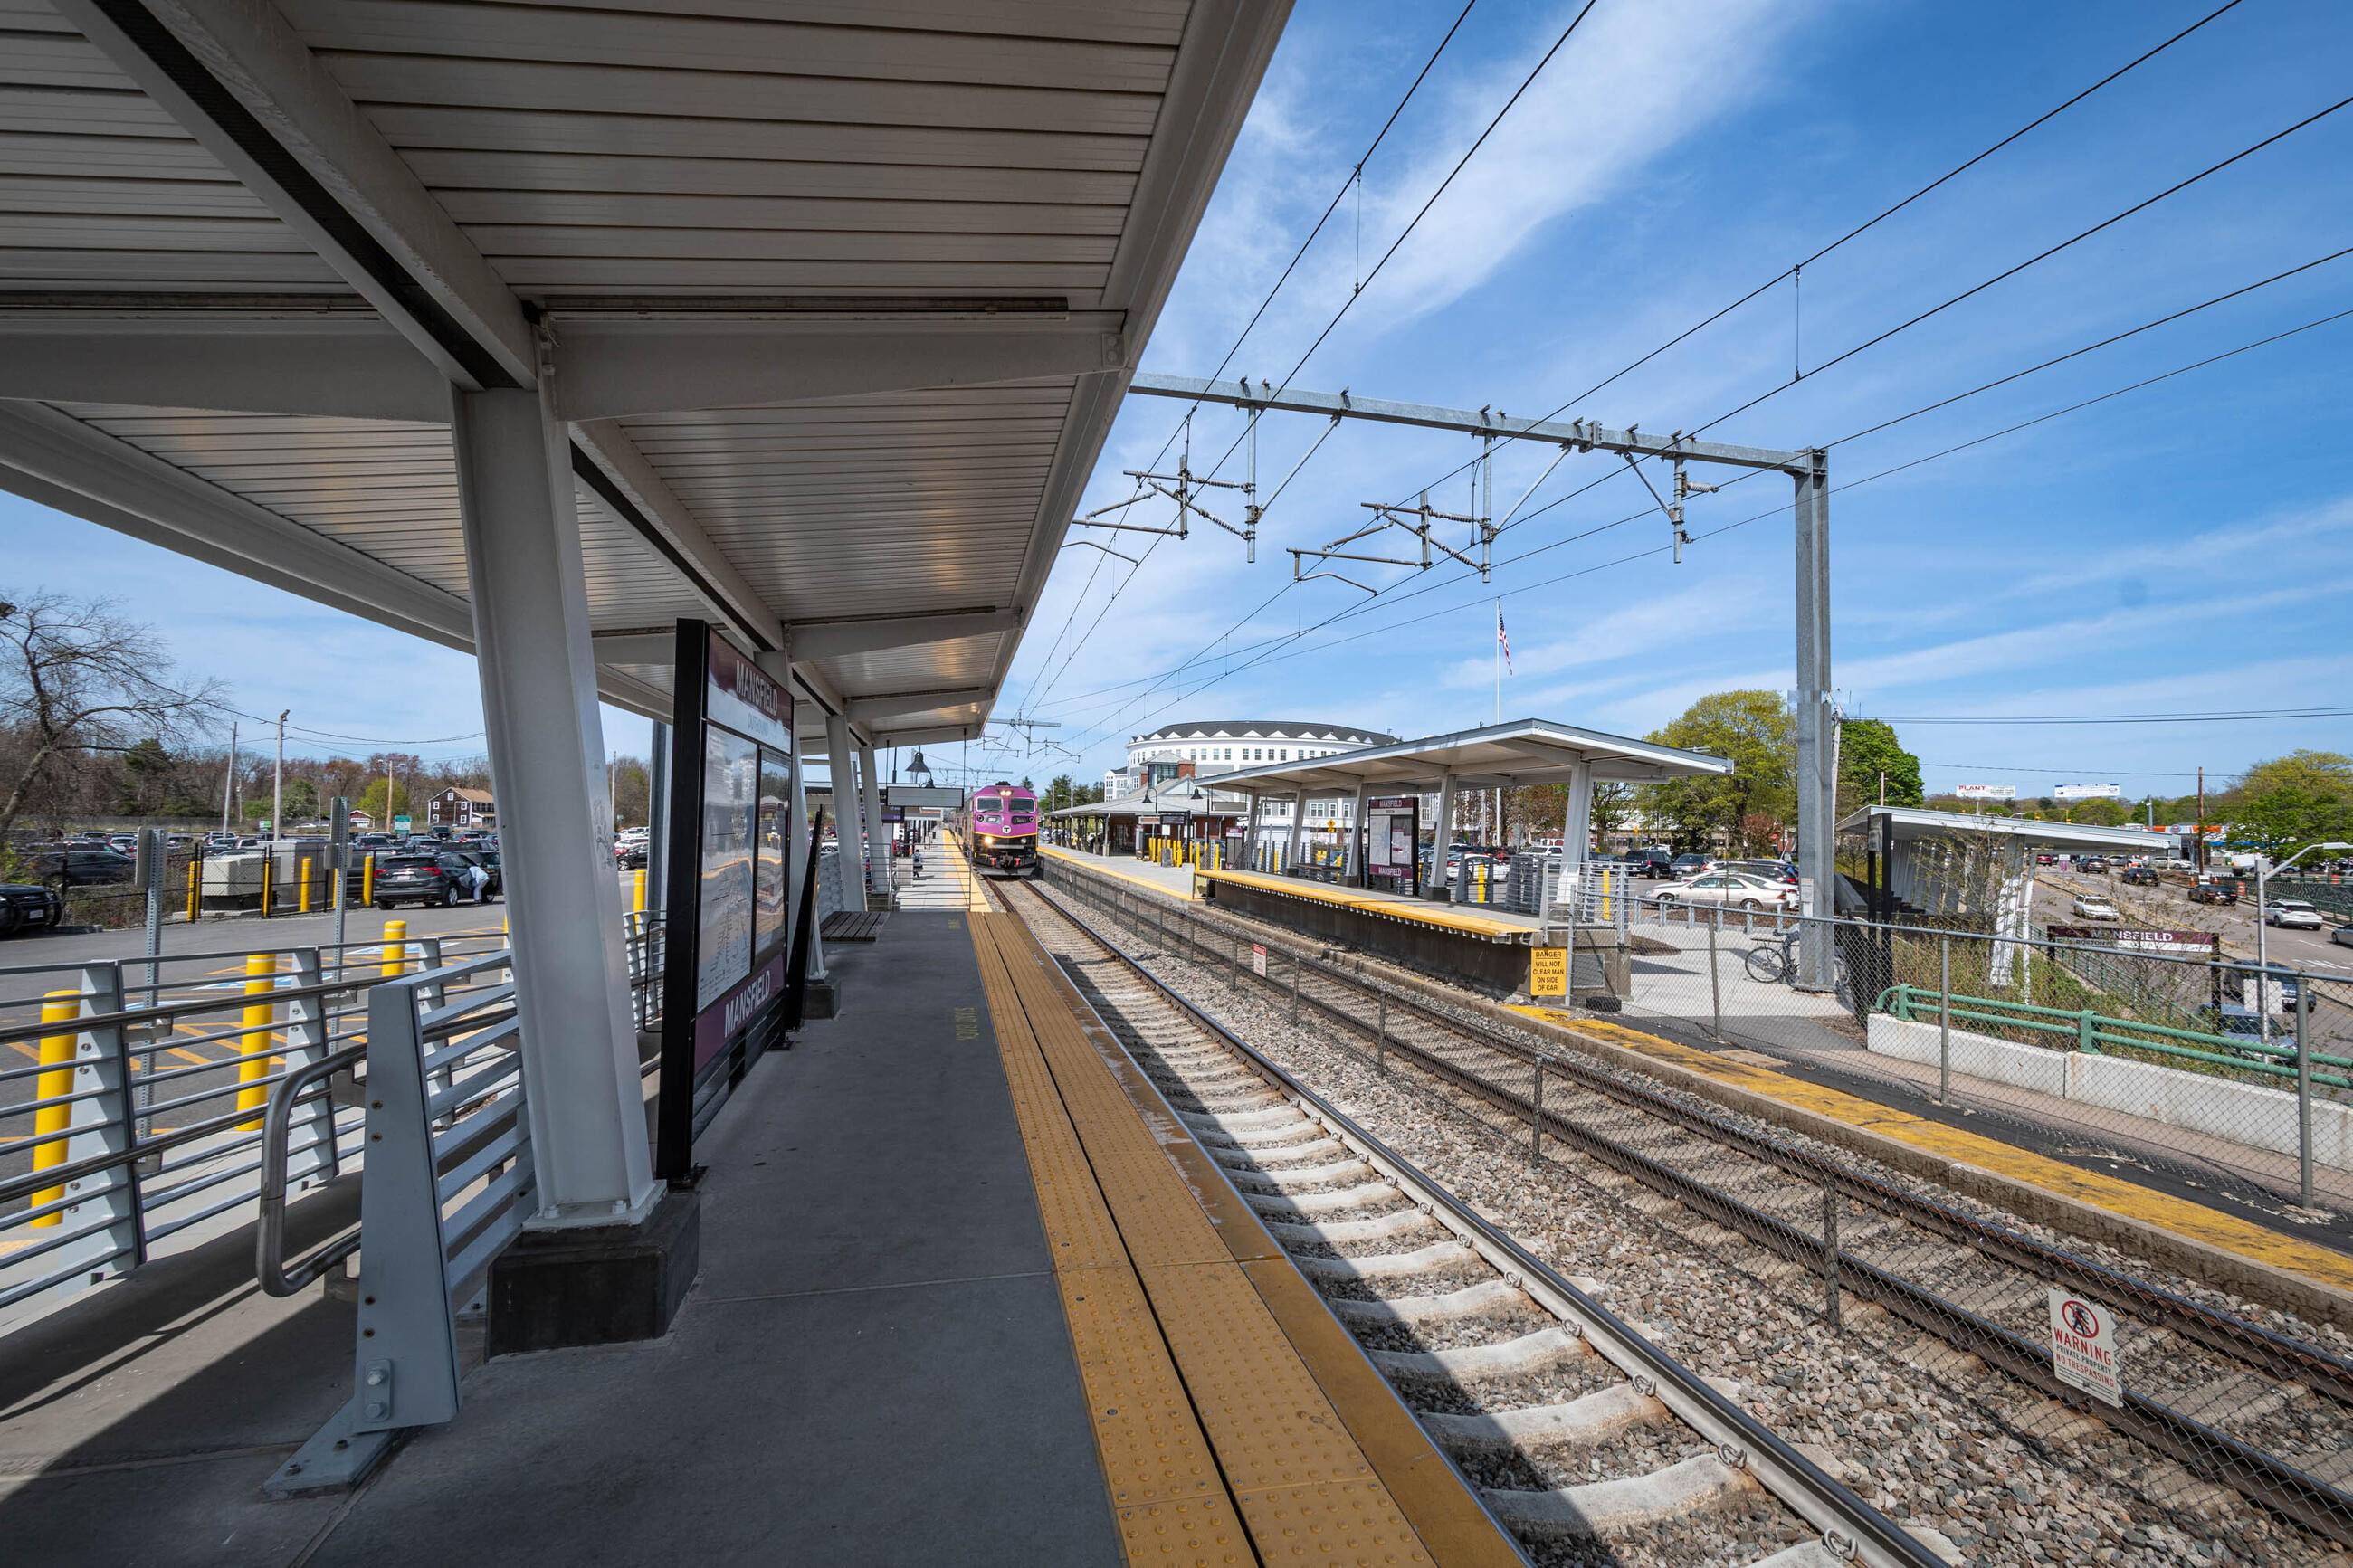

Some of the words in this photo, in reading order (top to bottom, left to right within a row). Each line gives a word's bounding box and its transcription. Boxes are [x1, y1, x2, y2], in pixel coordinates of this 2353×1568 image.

[736, 660, 777, 716] MANSFIELD
[1378, 867, 1402, 876] MANSFIELD
[2091, 931, 2173, 942] MNSFIELD
[724, 970, 771, 1039] MANSFIELD
[2053, 1326, 2111, 1366] WARNING
[2056, 1344, 2080, 1361] PRIVATE
[2082, 1356, 2111, 1374] PROPERTY
[2056, 1354, 2065, 1364] NO
[2068, 1358, 2114, 1388] TRESPASSING
